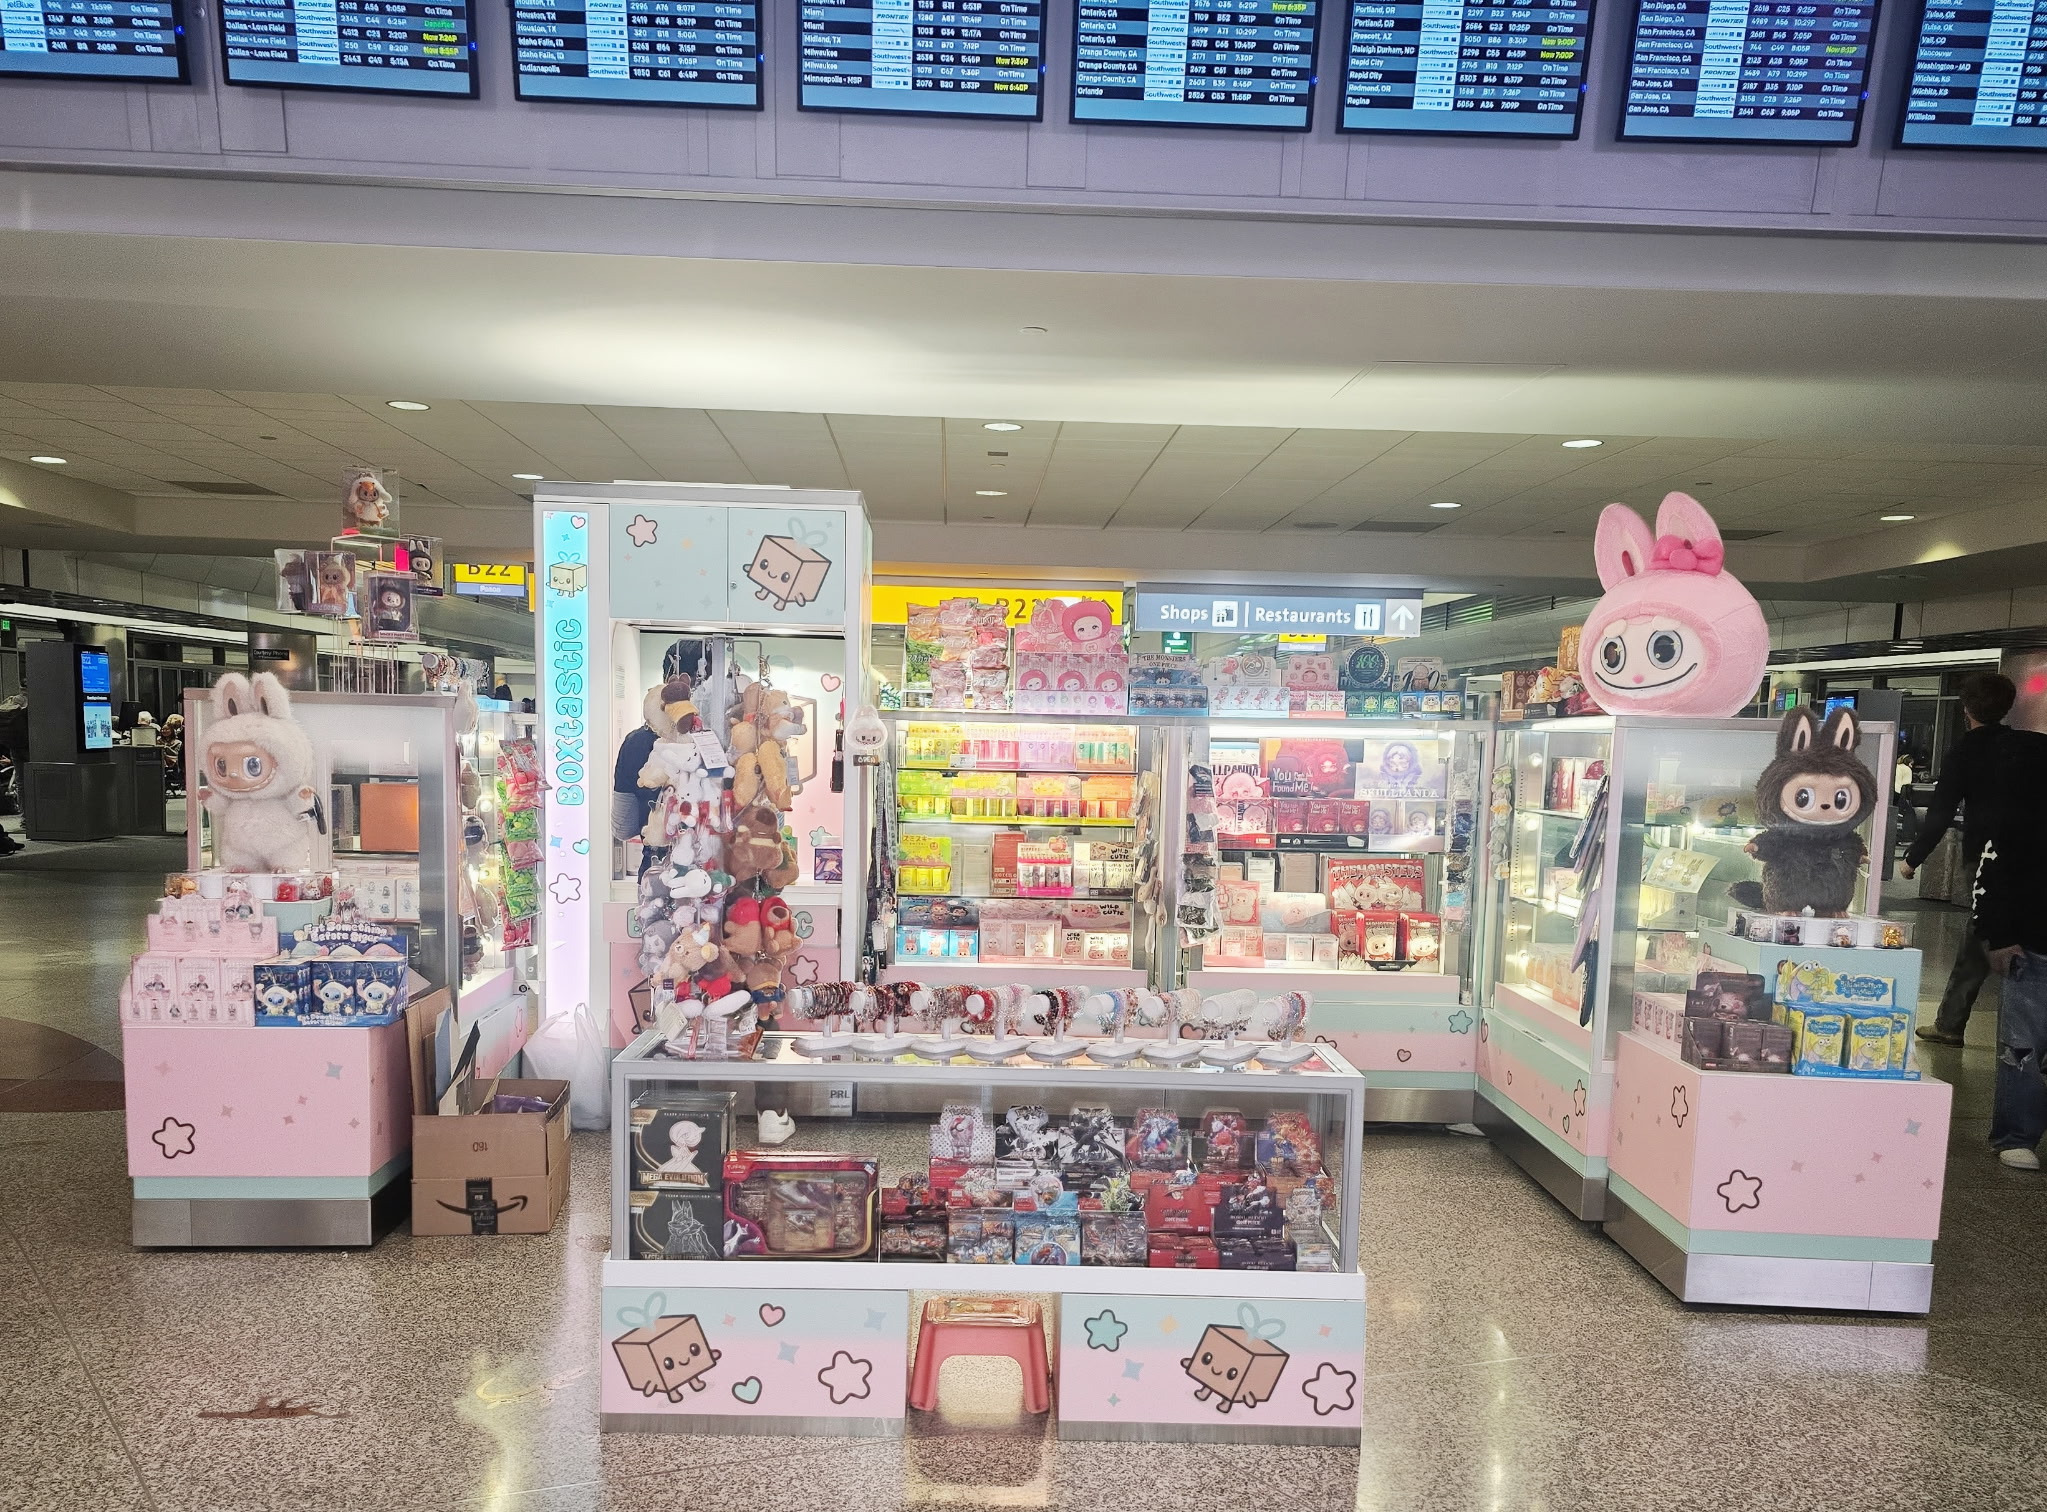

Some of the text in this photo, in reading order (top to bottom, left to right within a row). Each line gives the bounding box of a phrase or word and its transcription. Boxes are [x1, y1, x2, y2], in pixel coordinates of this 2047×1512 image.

[1161, 605, 1350, 624] Shops Restaurants
[1273, 768, 1291, 782] You
[1273, 781, 1294, 793] Found
[1360, 788, 1439, 798] SKULLPANDA
[304, 922, 387, 936] Eat Something
[311, 932, 348, 942] Before
[831, 1090, 850, 1098] PRL
[643, 1173, 704, 1184] MEGA EVOLUTION
